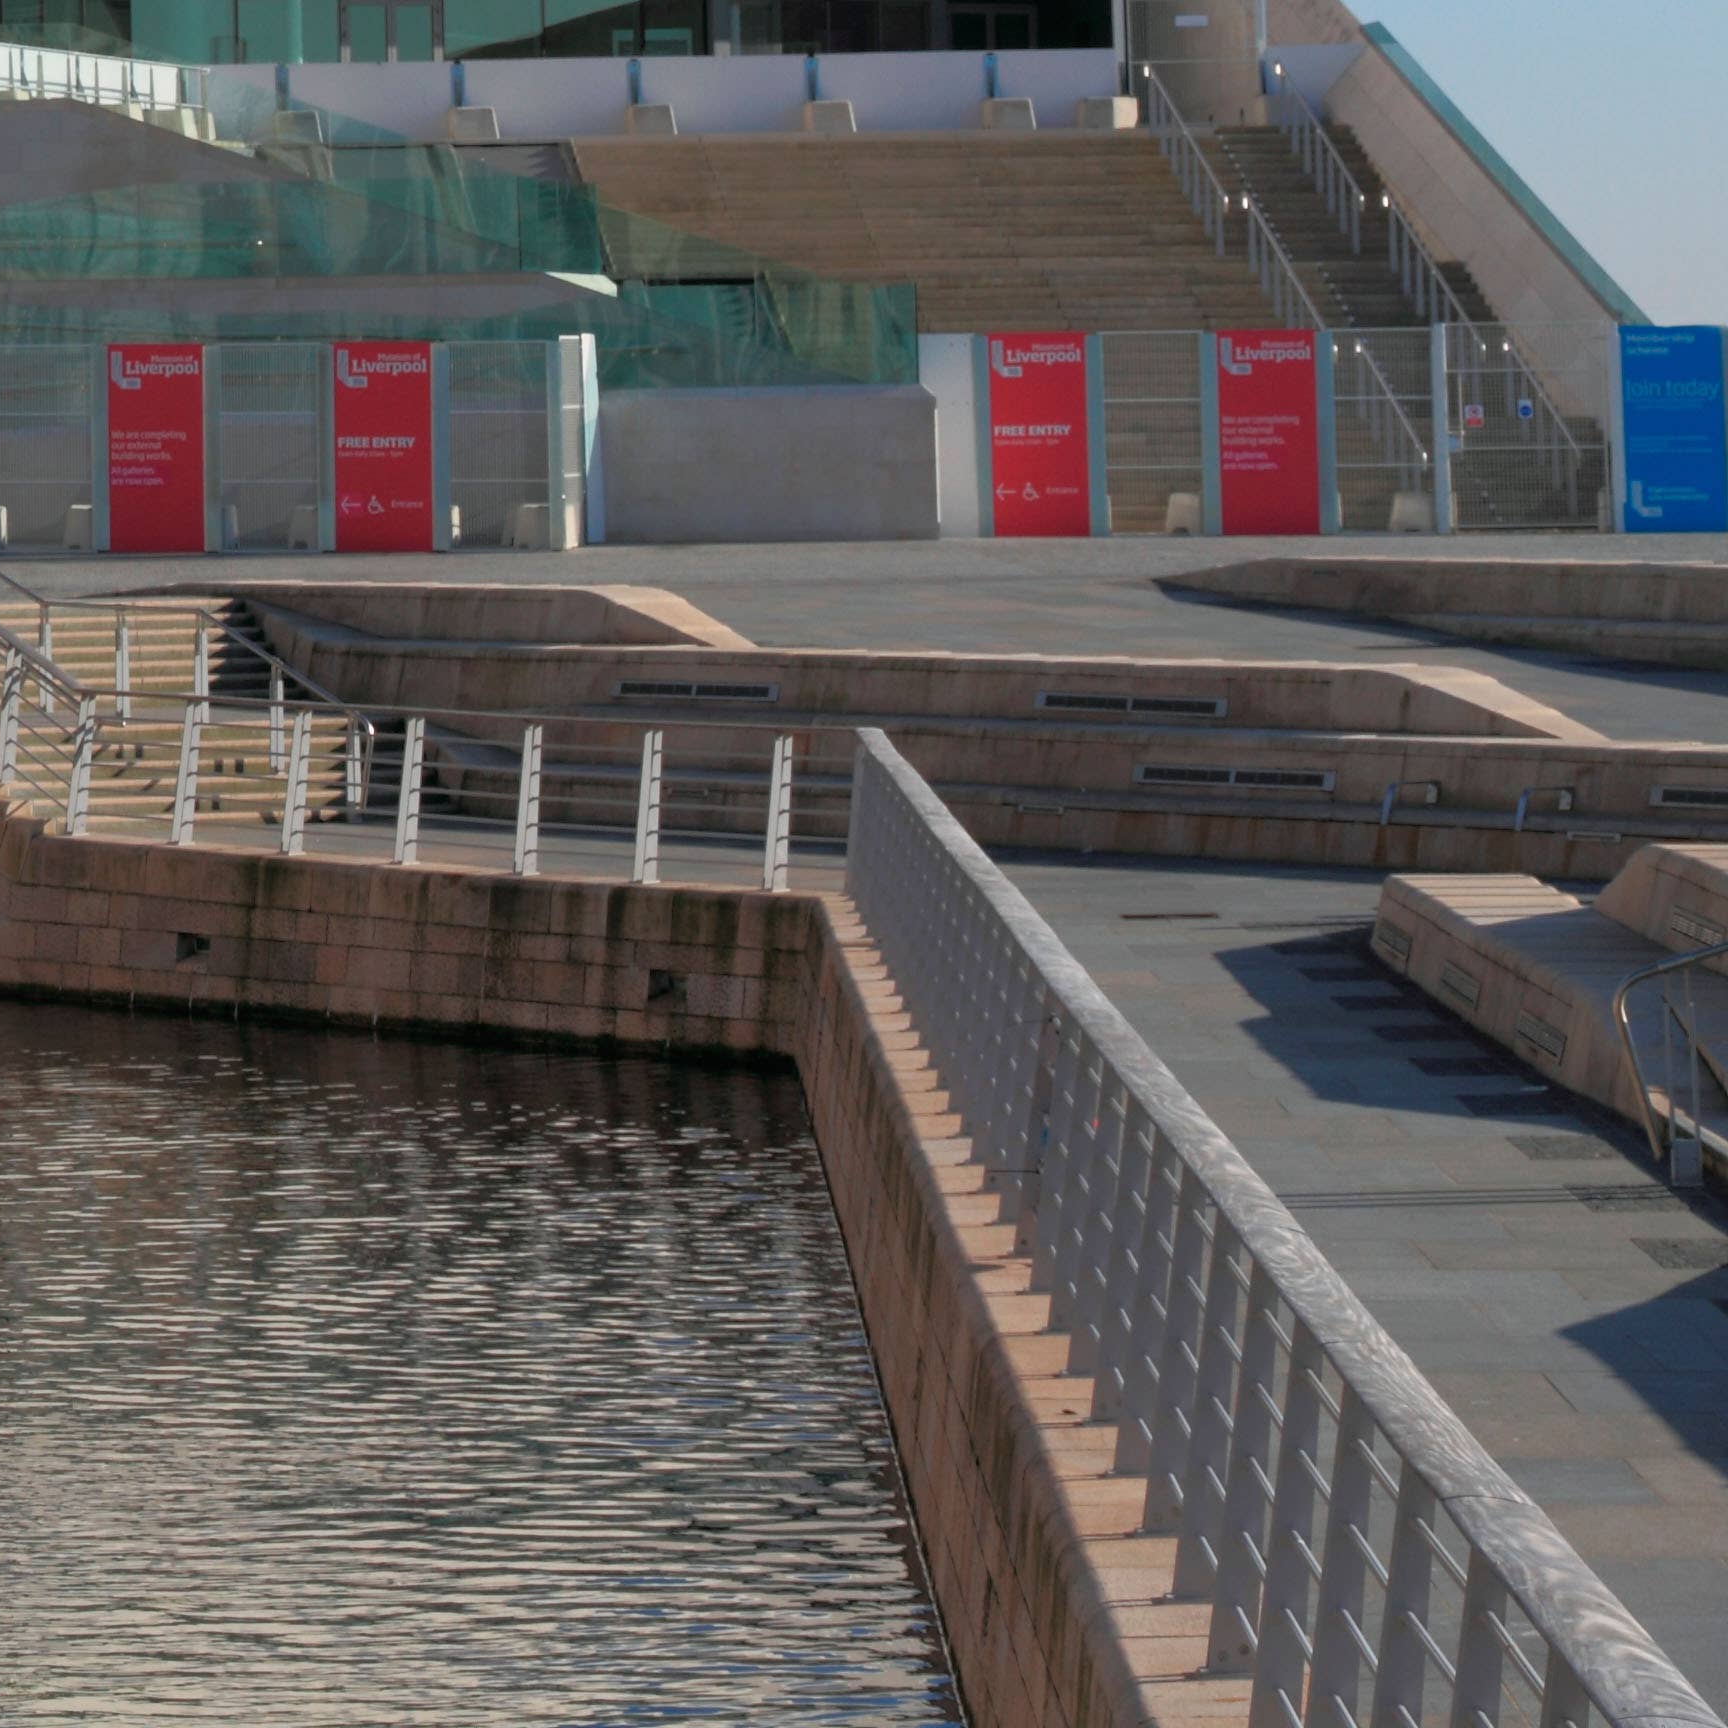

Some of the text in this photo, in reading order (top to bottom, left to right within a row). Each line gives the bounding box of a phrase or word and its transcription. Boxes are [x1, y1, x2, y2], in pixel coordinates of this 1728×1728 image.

[1626, 334, 1695, 345] Membership
[1006, 349, 1081, 366] Liverpool
[1236, 346, 1312, 362] Liverpool
[125, 360, 200, 378] Liverpool
[352, 358, 427, 376] Liverpool
[1666, 378, 1719, 400] today
[994, 424, 1072, 437] FREE ENTRY
[337, 436, 415, 448] FREE ENTRY
